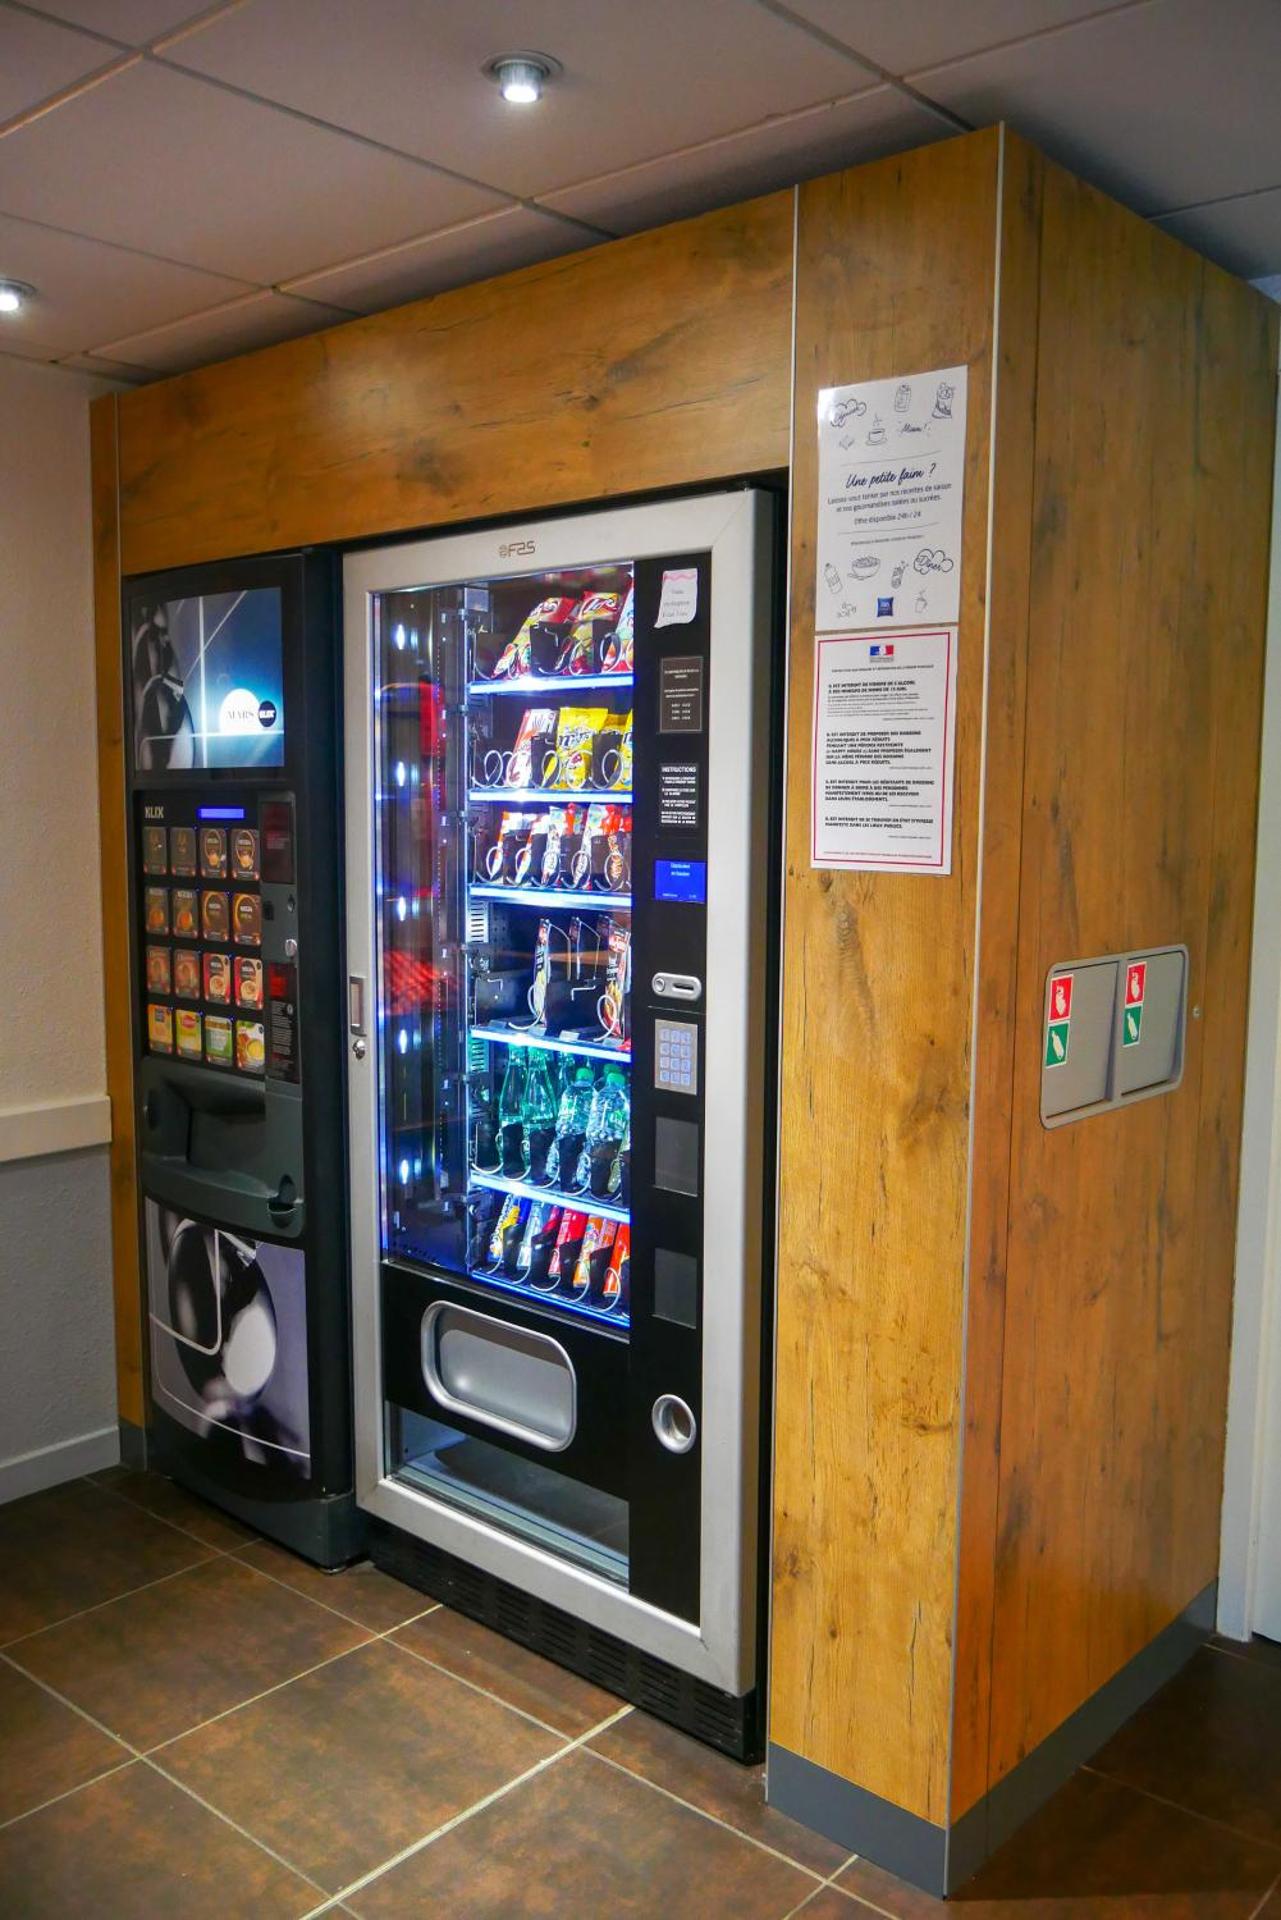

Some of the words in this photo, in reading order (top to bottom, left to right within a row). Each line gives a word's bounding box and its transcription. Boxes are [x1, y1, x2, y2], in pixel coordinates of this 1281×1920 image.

[846, 473, 866, 489] Une
[868, 471, 896, 488] petite
[898, 467, 924, 486] faim
[929, 462, 936, 478] ?
[145, 806, 164, 818] KLIX
